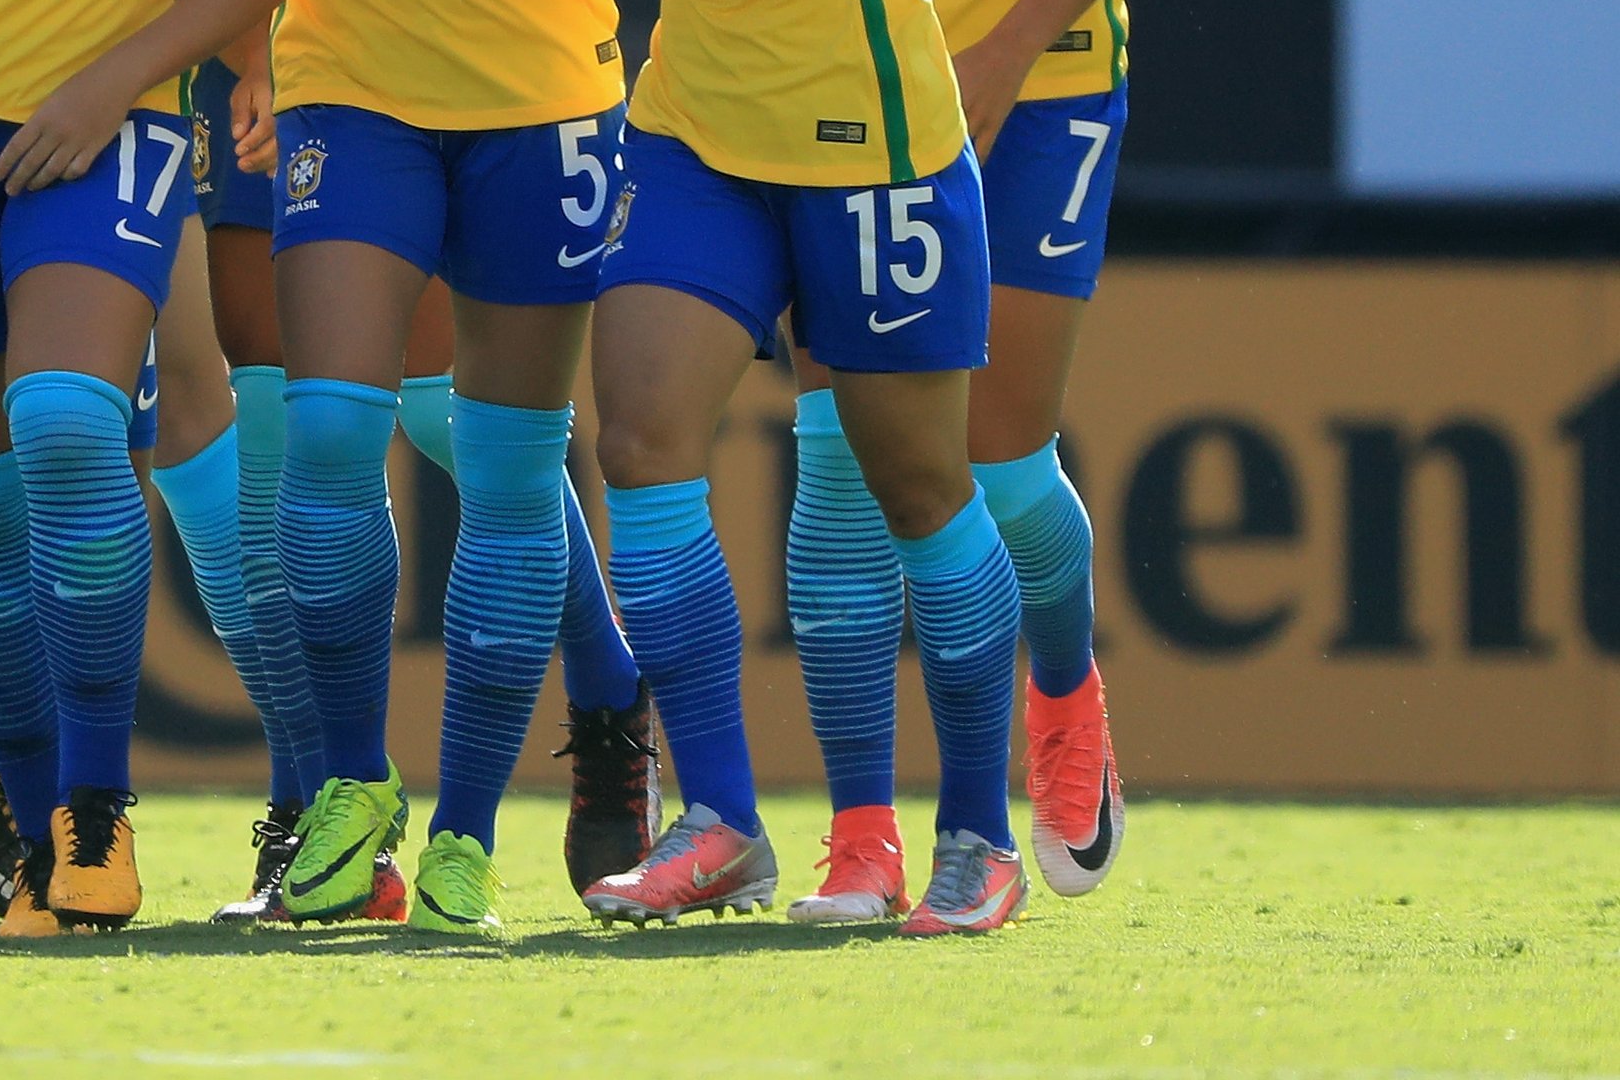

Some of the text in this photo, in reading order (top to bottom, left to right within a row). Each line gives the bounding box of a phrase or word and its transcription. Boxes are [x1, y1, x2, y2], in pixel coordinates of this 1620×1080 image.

[117, 120, 188, 217] 17
[284, 199, 320, 217] BRASIL
[558, 118, 608, 228] 5
[1068, 120, 1110, 223] 7
[846, 185, 943, 296] 15
